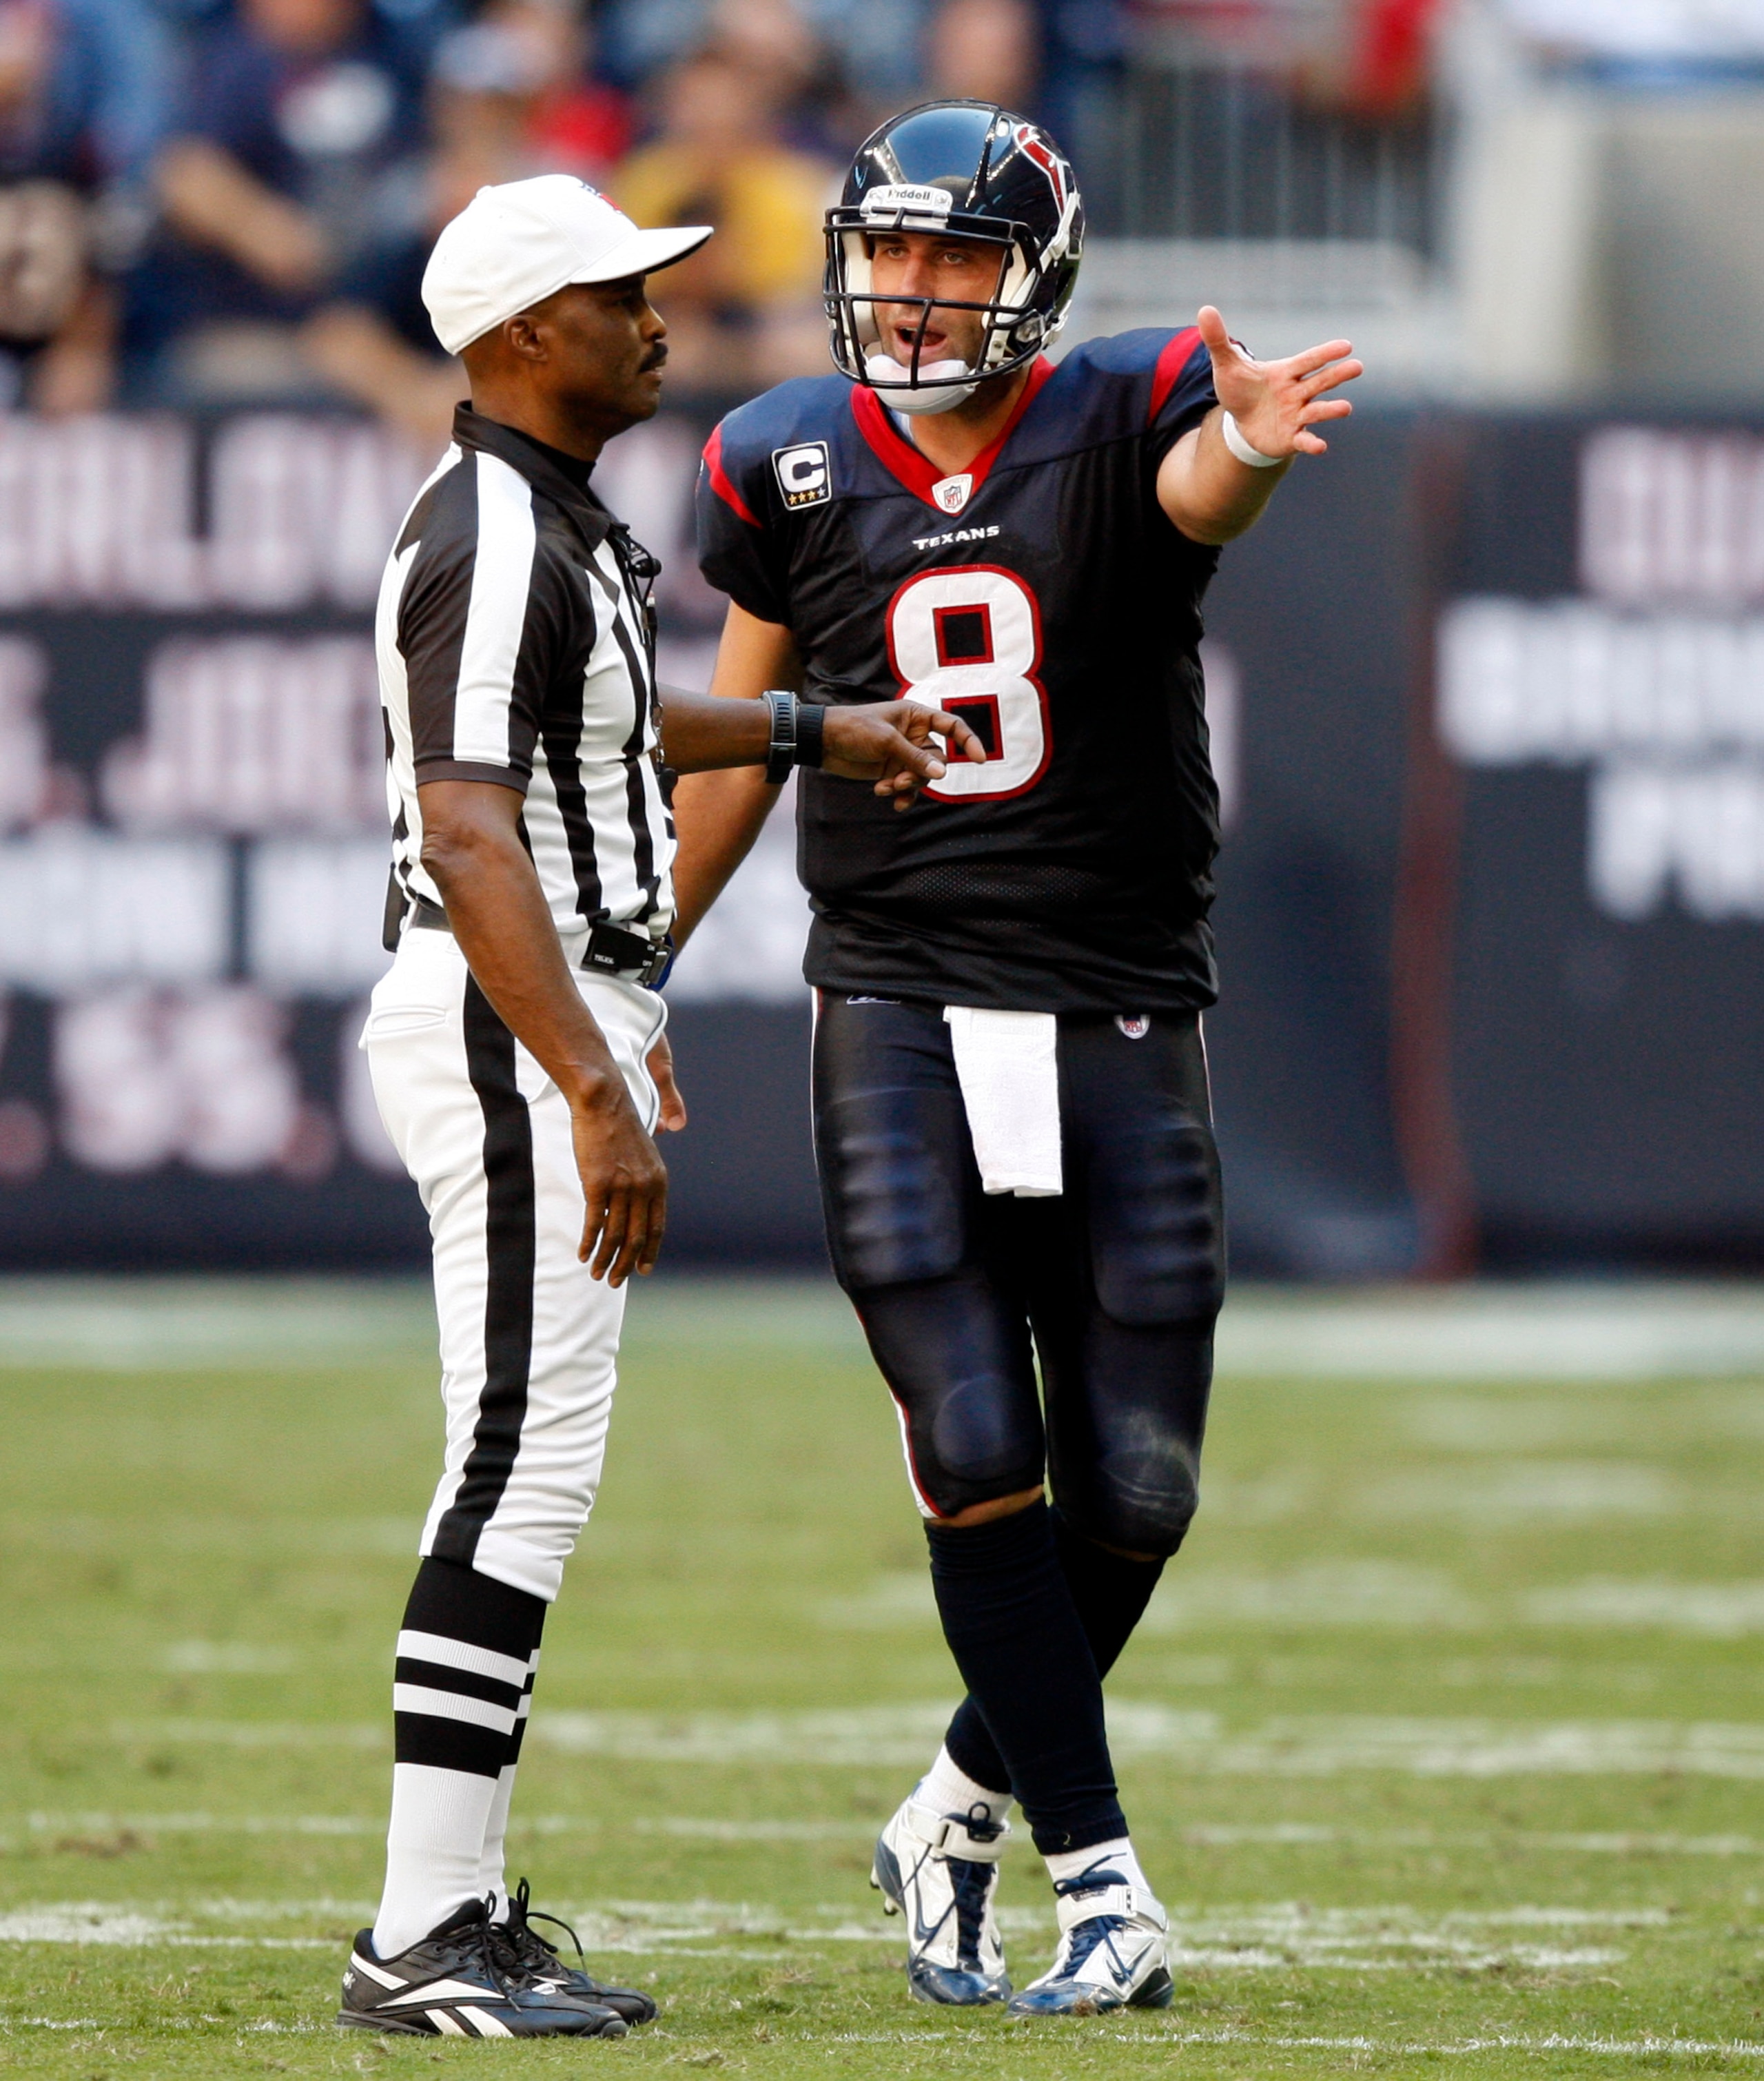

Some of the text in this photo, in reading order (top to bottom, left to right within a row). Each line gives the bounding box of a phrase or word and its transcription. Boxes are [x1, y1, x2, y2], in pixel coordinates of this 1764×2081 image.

[778, 448, 825, 493] C
[912, 525, 1000, 551] TEXANS
[885, 564, 1053, 804] 8
